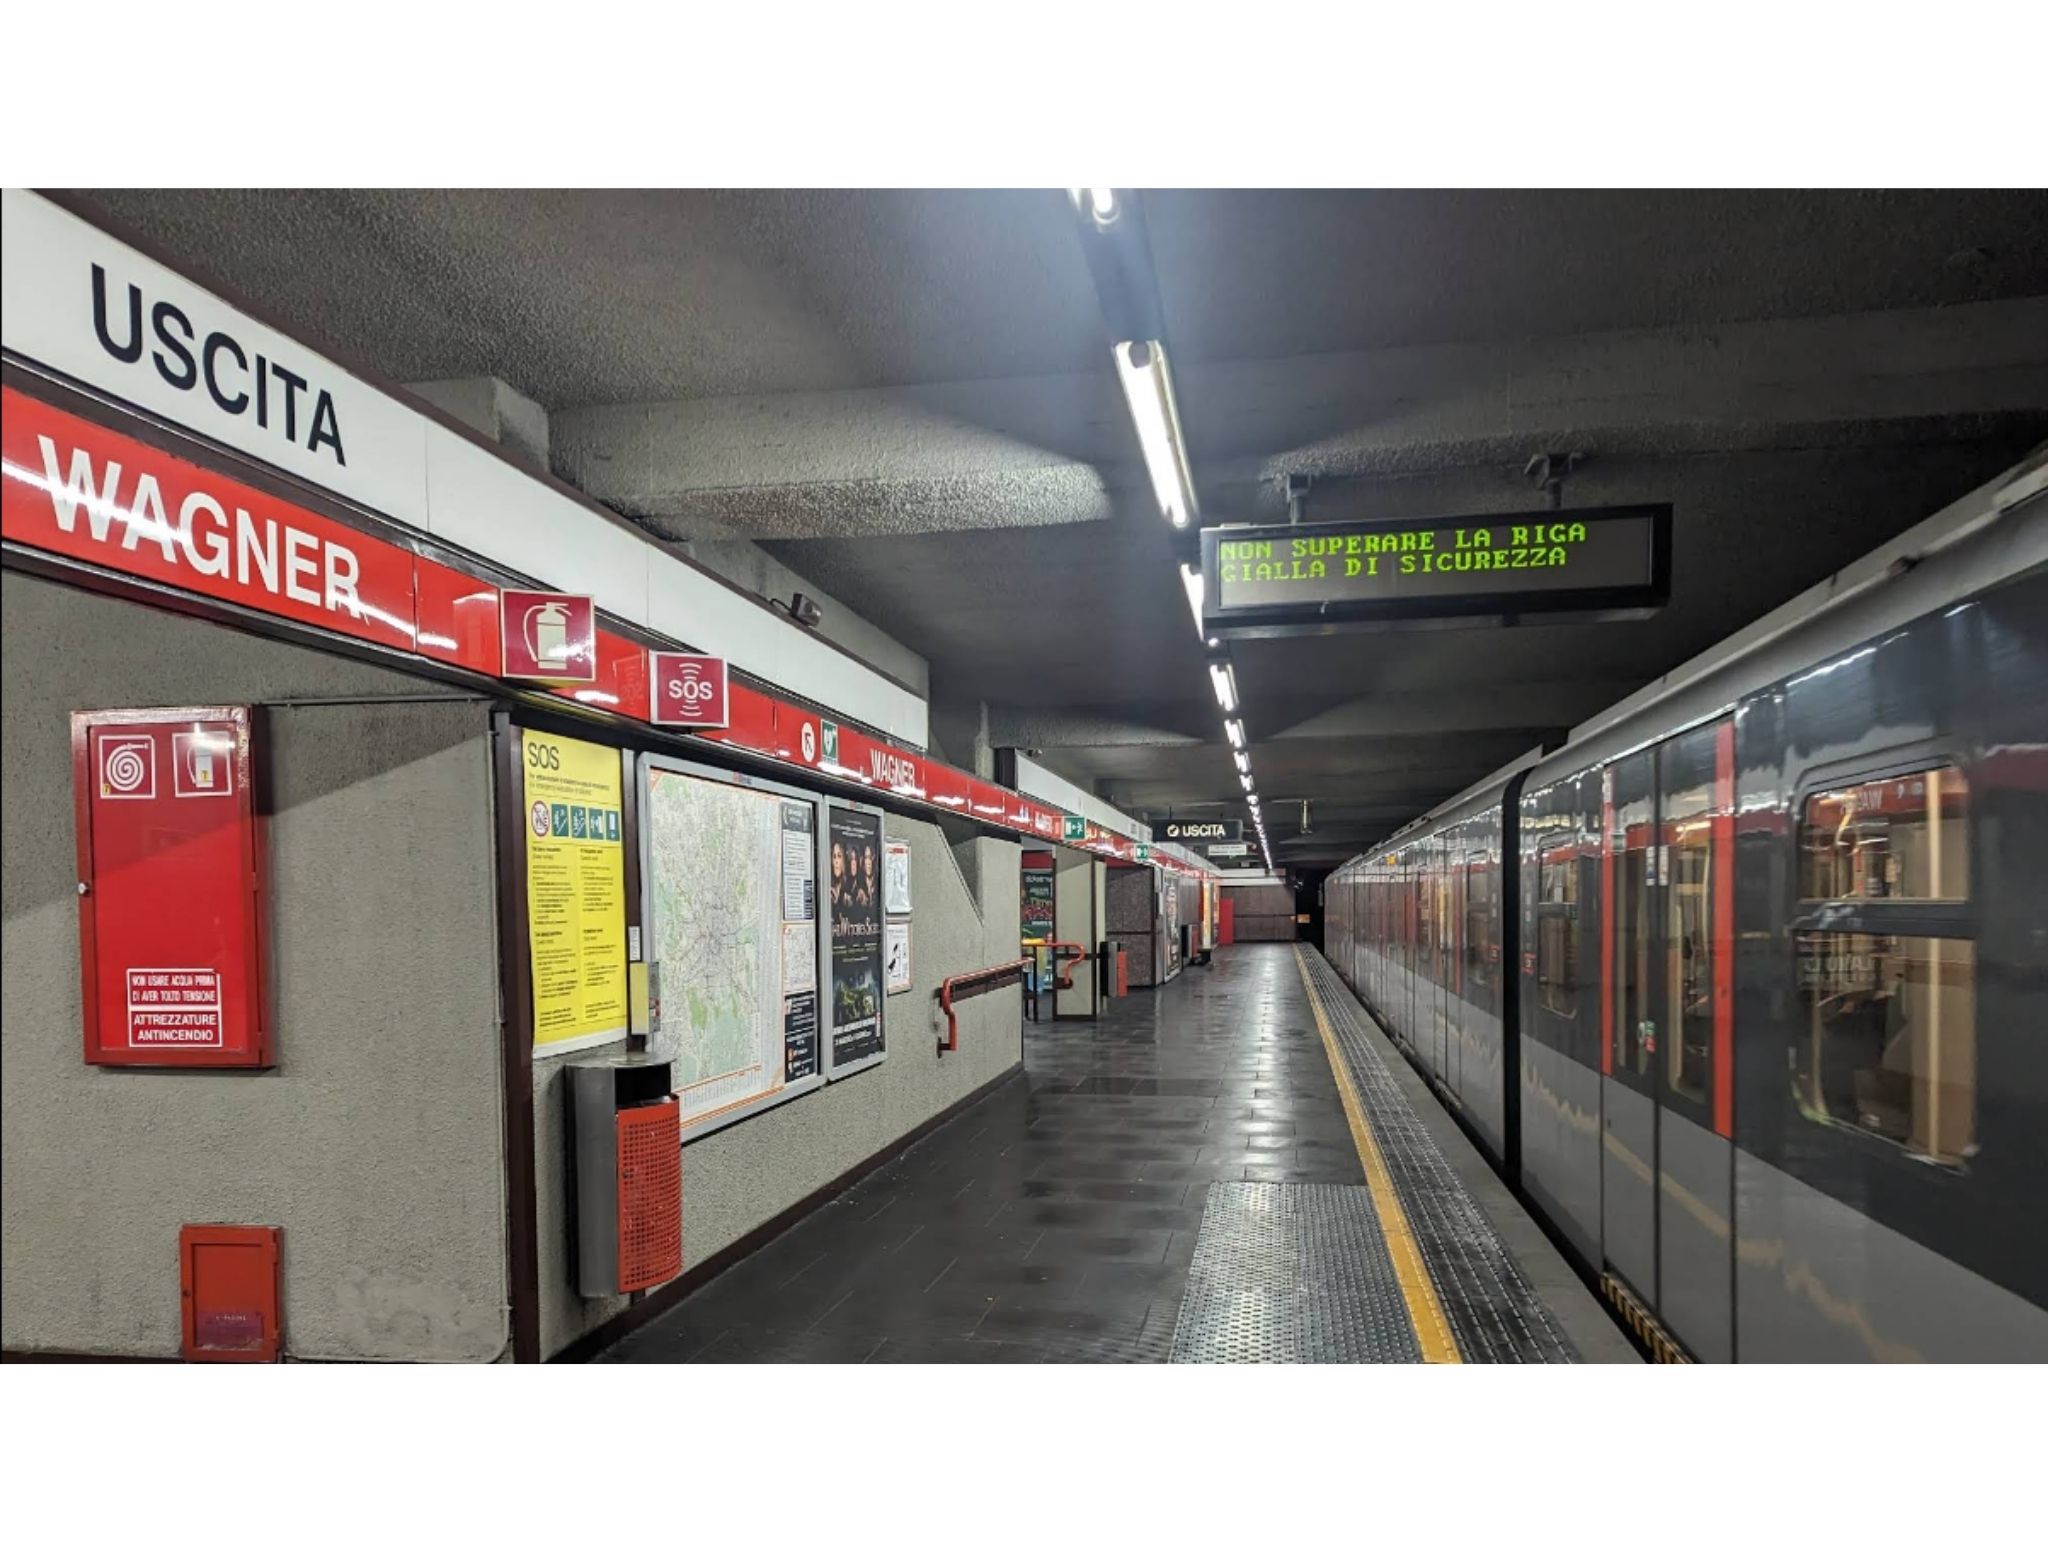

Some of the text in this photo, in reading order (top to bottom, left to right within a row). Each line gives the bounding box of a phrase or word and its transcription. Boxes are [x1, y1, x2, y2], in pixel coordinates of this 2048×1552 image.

[91, 262, 346, 467] USCITA
[37, 434, 363, 619] WAGNER
[1220, 522, 1586, 560] NON SUPERARE LA RIGA
[1220, 546, 1567, 583] GIALLA DI SICUREZZA
[668, 679, 713, 700] SOS
[527, 742, 560, 771] SOS
[870, 749, 915, 789] WAGNER
[1182, 824, 1226, 838] USCITA
[134, 1014, 217, 1026] ATTREZZATURE
[137, 1029, 214, 1041] ANTINCENDIO
